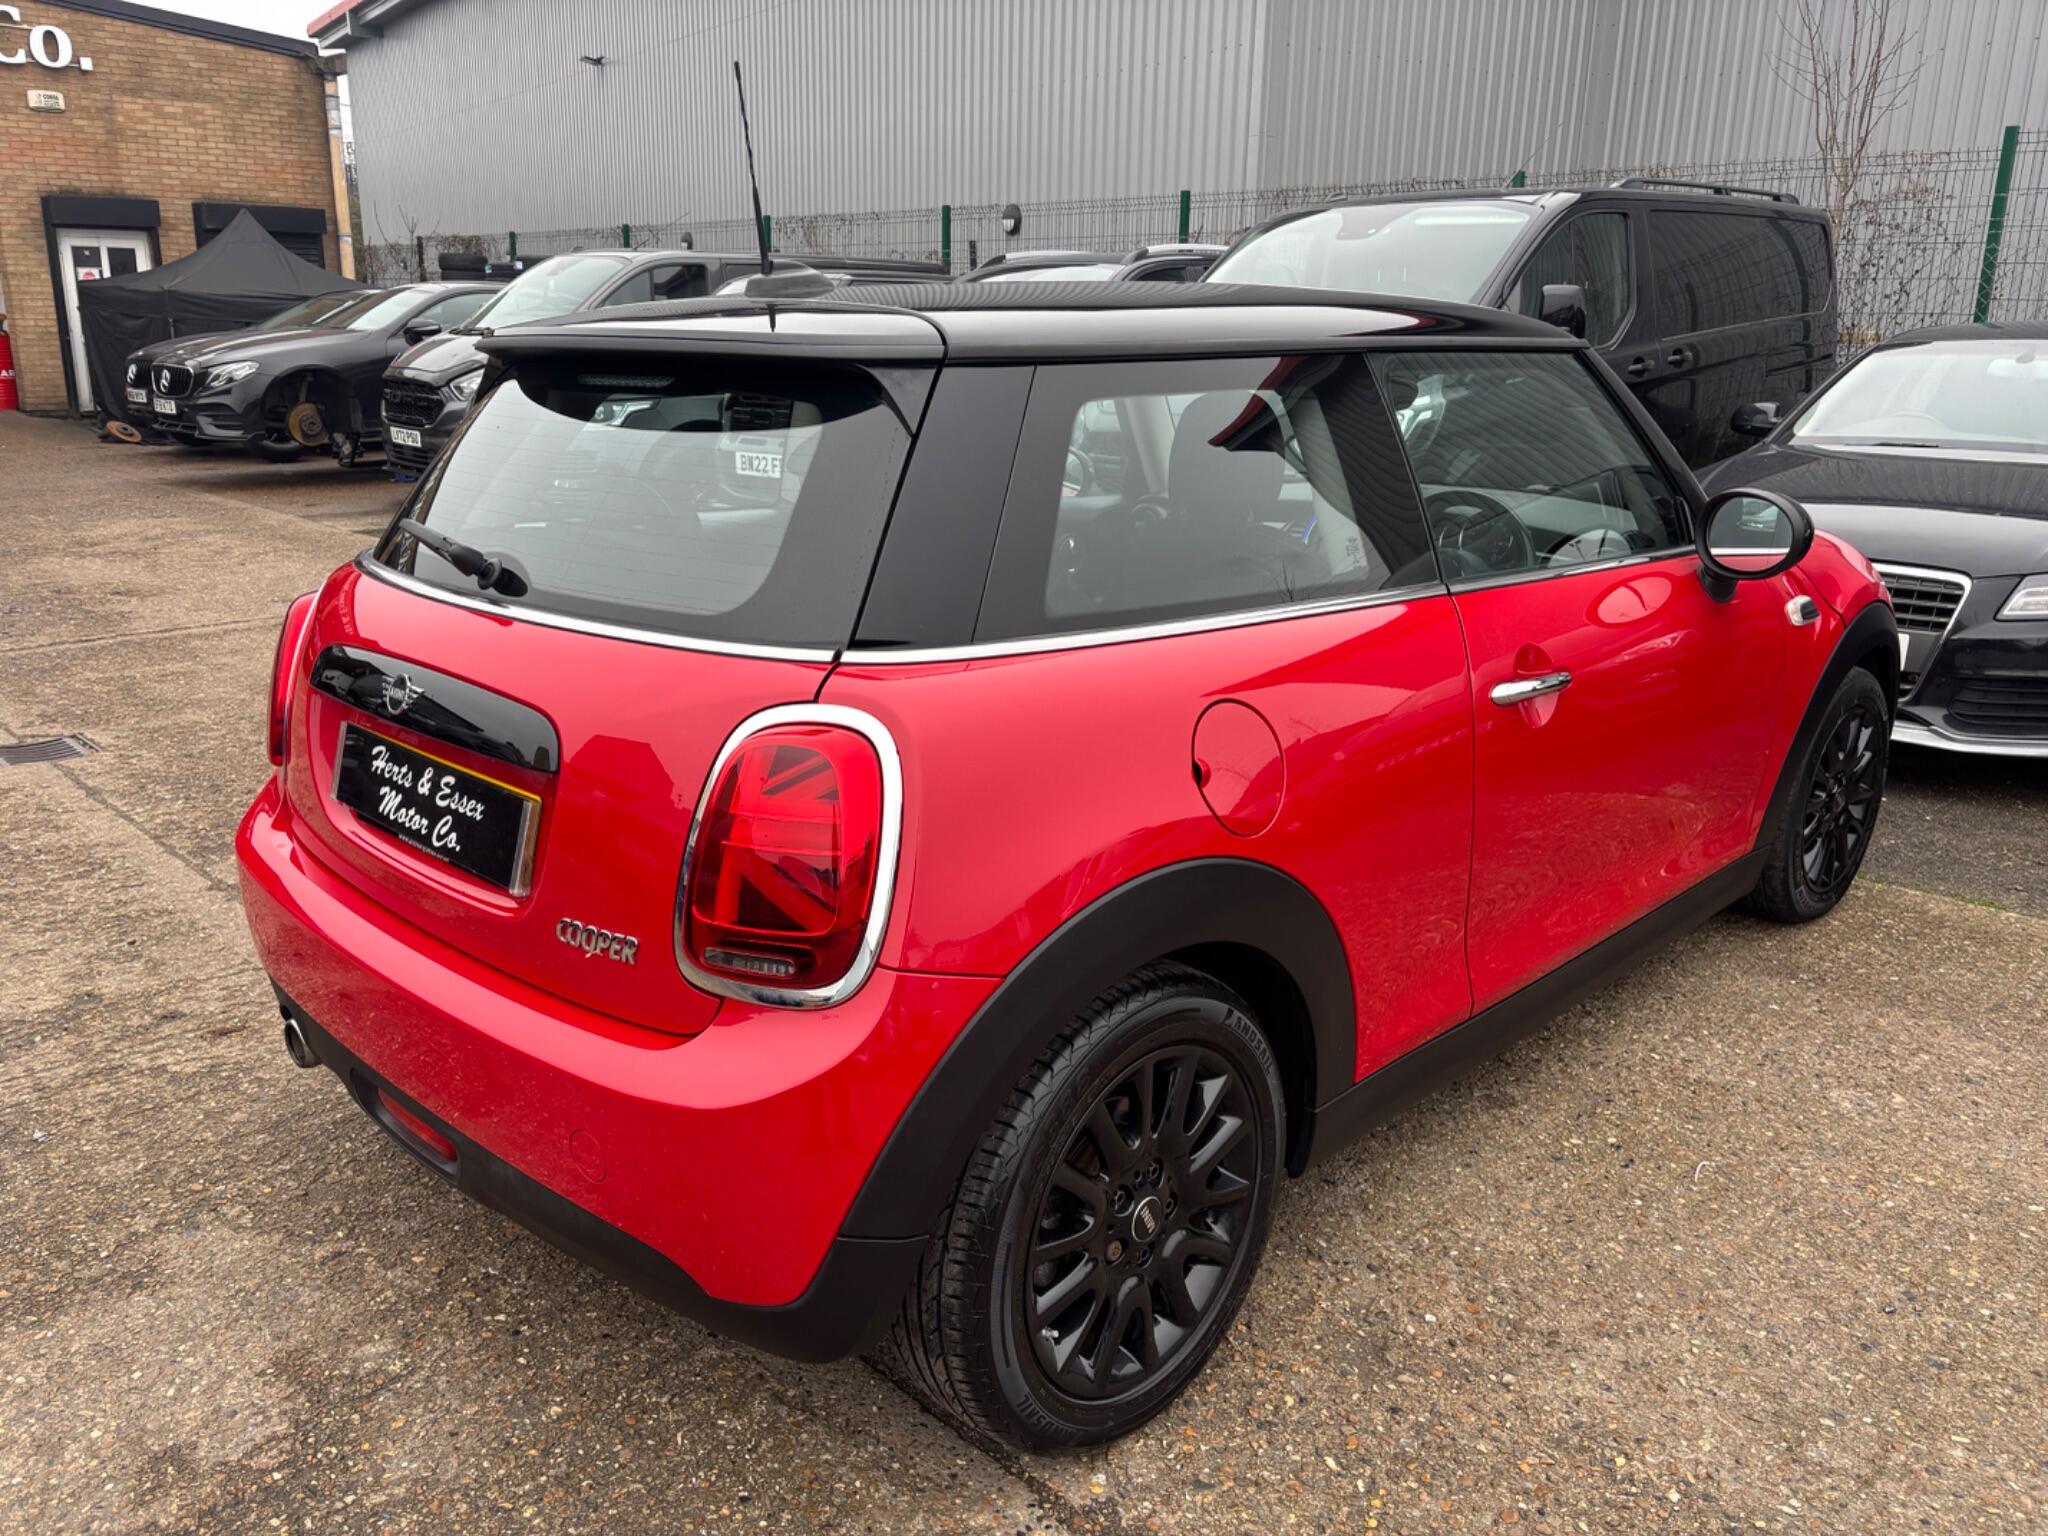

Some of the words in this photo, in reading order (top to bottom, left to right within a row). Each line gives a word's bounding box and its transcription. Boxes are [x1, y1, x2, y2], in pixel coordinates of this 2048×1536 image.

[371, 745, 413, 788] Herts
[417, 766, 434, 797] &
[435, 775, 485, 821] Essex
[378, 785, 429, 835] Motor
[432, 815, 461, 852] Co.
[556, 917, 639, 966] COOPER
[1140, 1205, 1156, 1234] MINI
